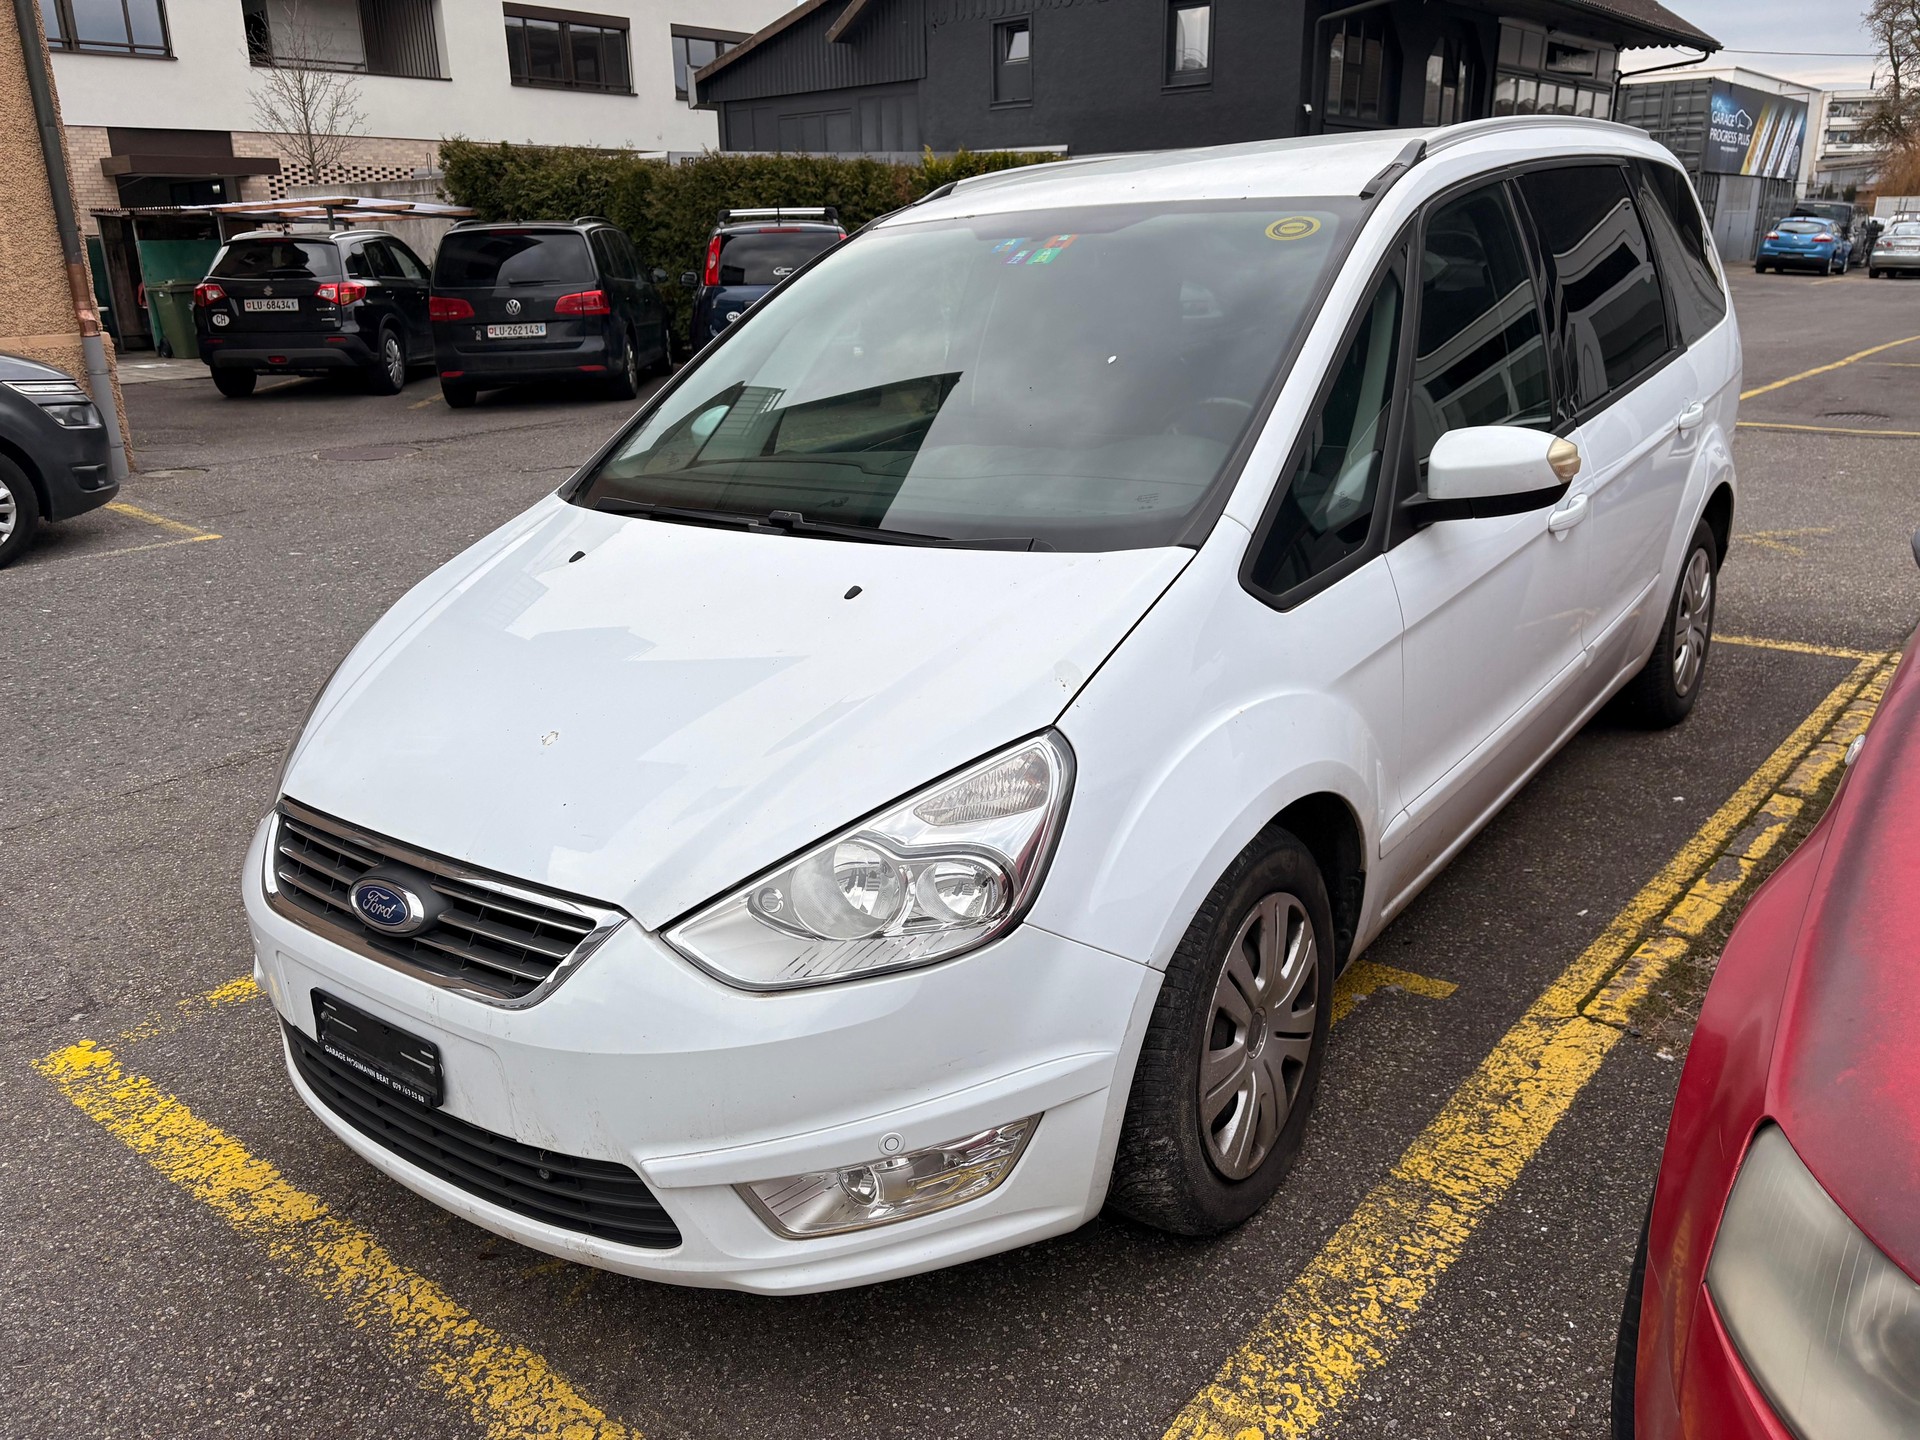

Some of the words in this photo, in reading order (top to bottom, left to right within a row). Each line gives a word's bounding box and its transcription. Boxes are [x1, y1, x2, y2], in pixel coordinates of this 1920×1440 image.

[1711, 111, 1735, 127] GARAGE
[1709, 127, 1738, 144] PROGRESS
[1737, 132, 1751, 146] PLUS
[215, 314, 227, 325] CH
[362, 890, 397, 919] Ford
[324, 1044, 347, 1062] GARAGE
[375, 1072, 390, 1085] BEAT
